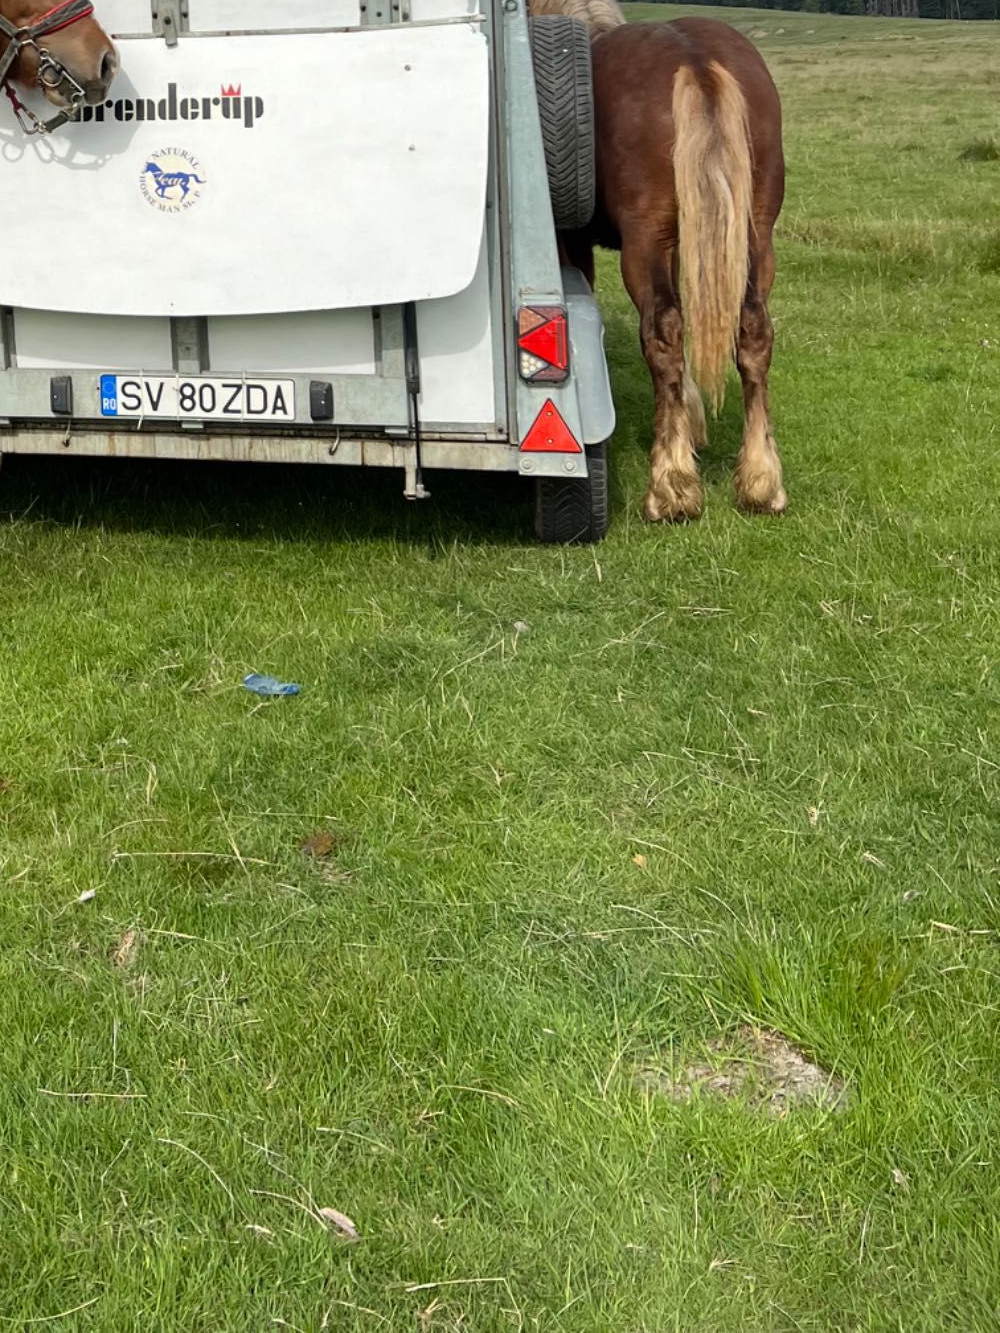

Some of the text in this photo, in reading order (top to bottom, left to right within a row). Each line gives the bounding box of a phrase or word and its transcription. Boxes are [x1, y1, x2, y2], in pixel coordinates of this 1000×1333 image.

[151, 147, 200, 170] NATURAL
[103, 398, 117, 410] RO
[121, 381, 164, 411] SV
